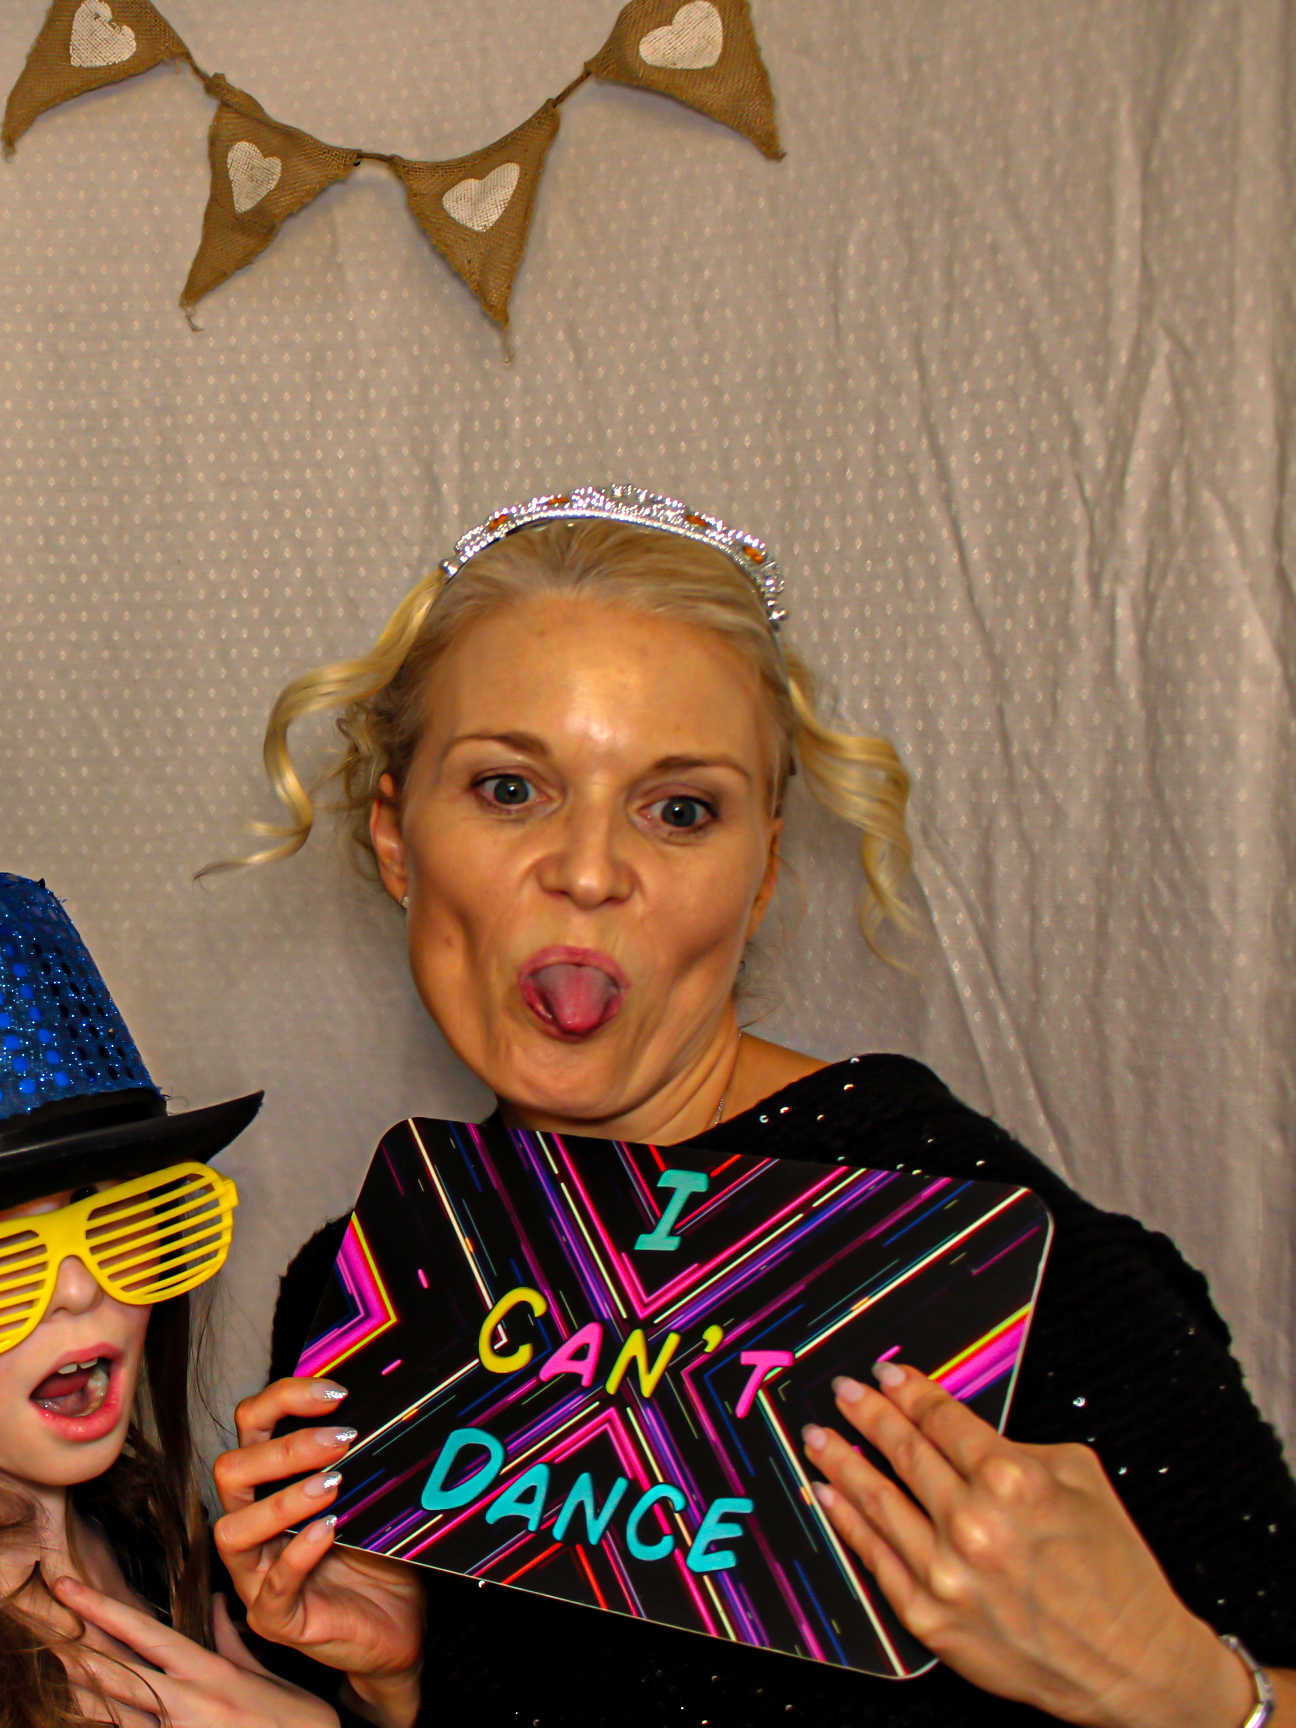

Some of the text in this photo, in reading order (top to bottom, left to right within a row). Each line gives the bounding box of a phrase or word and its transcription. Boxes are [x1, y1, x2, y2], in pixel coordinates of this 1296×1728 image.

[632, 1168, 710, 1252] I
[477, 1286, 796, 1419] CAN'T
[419, 1426, 755, 1574] DANCE
